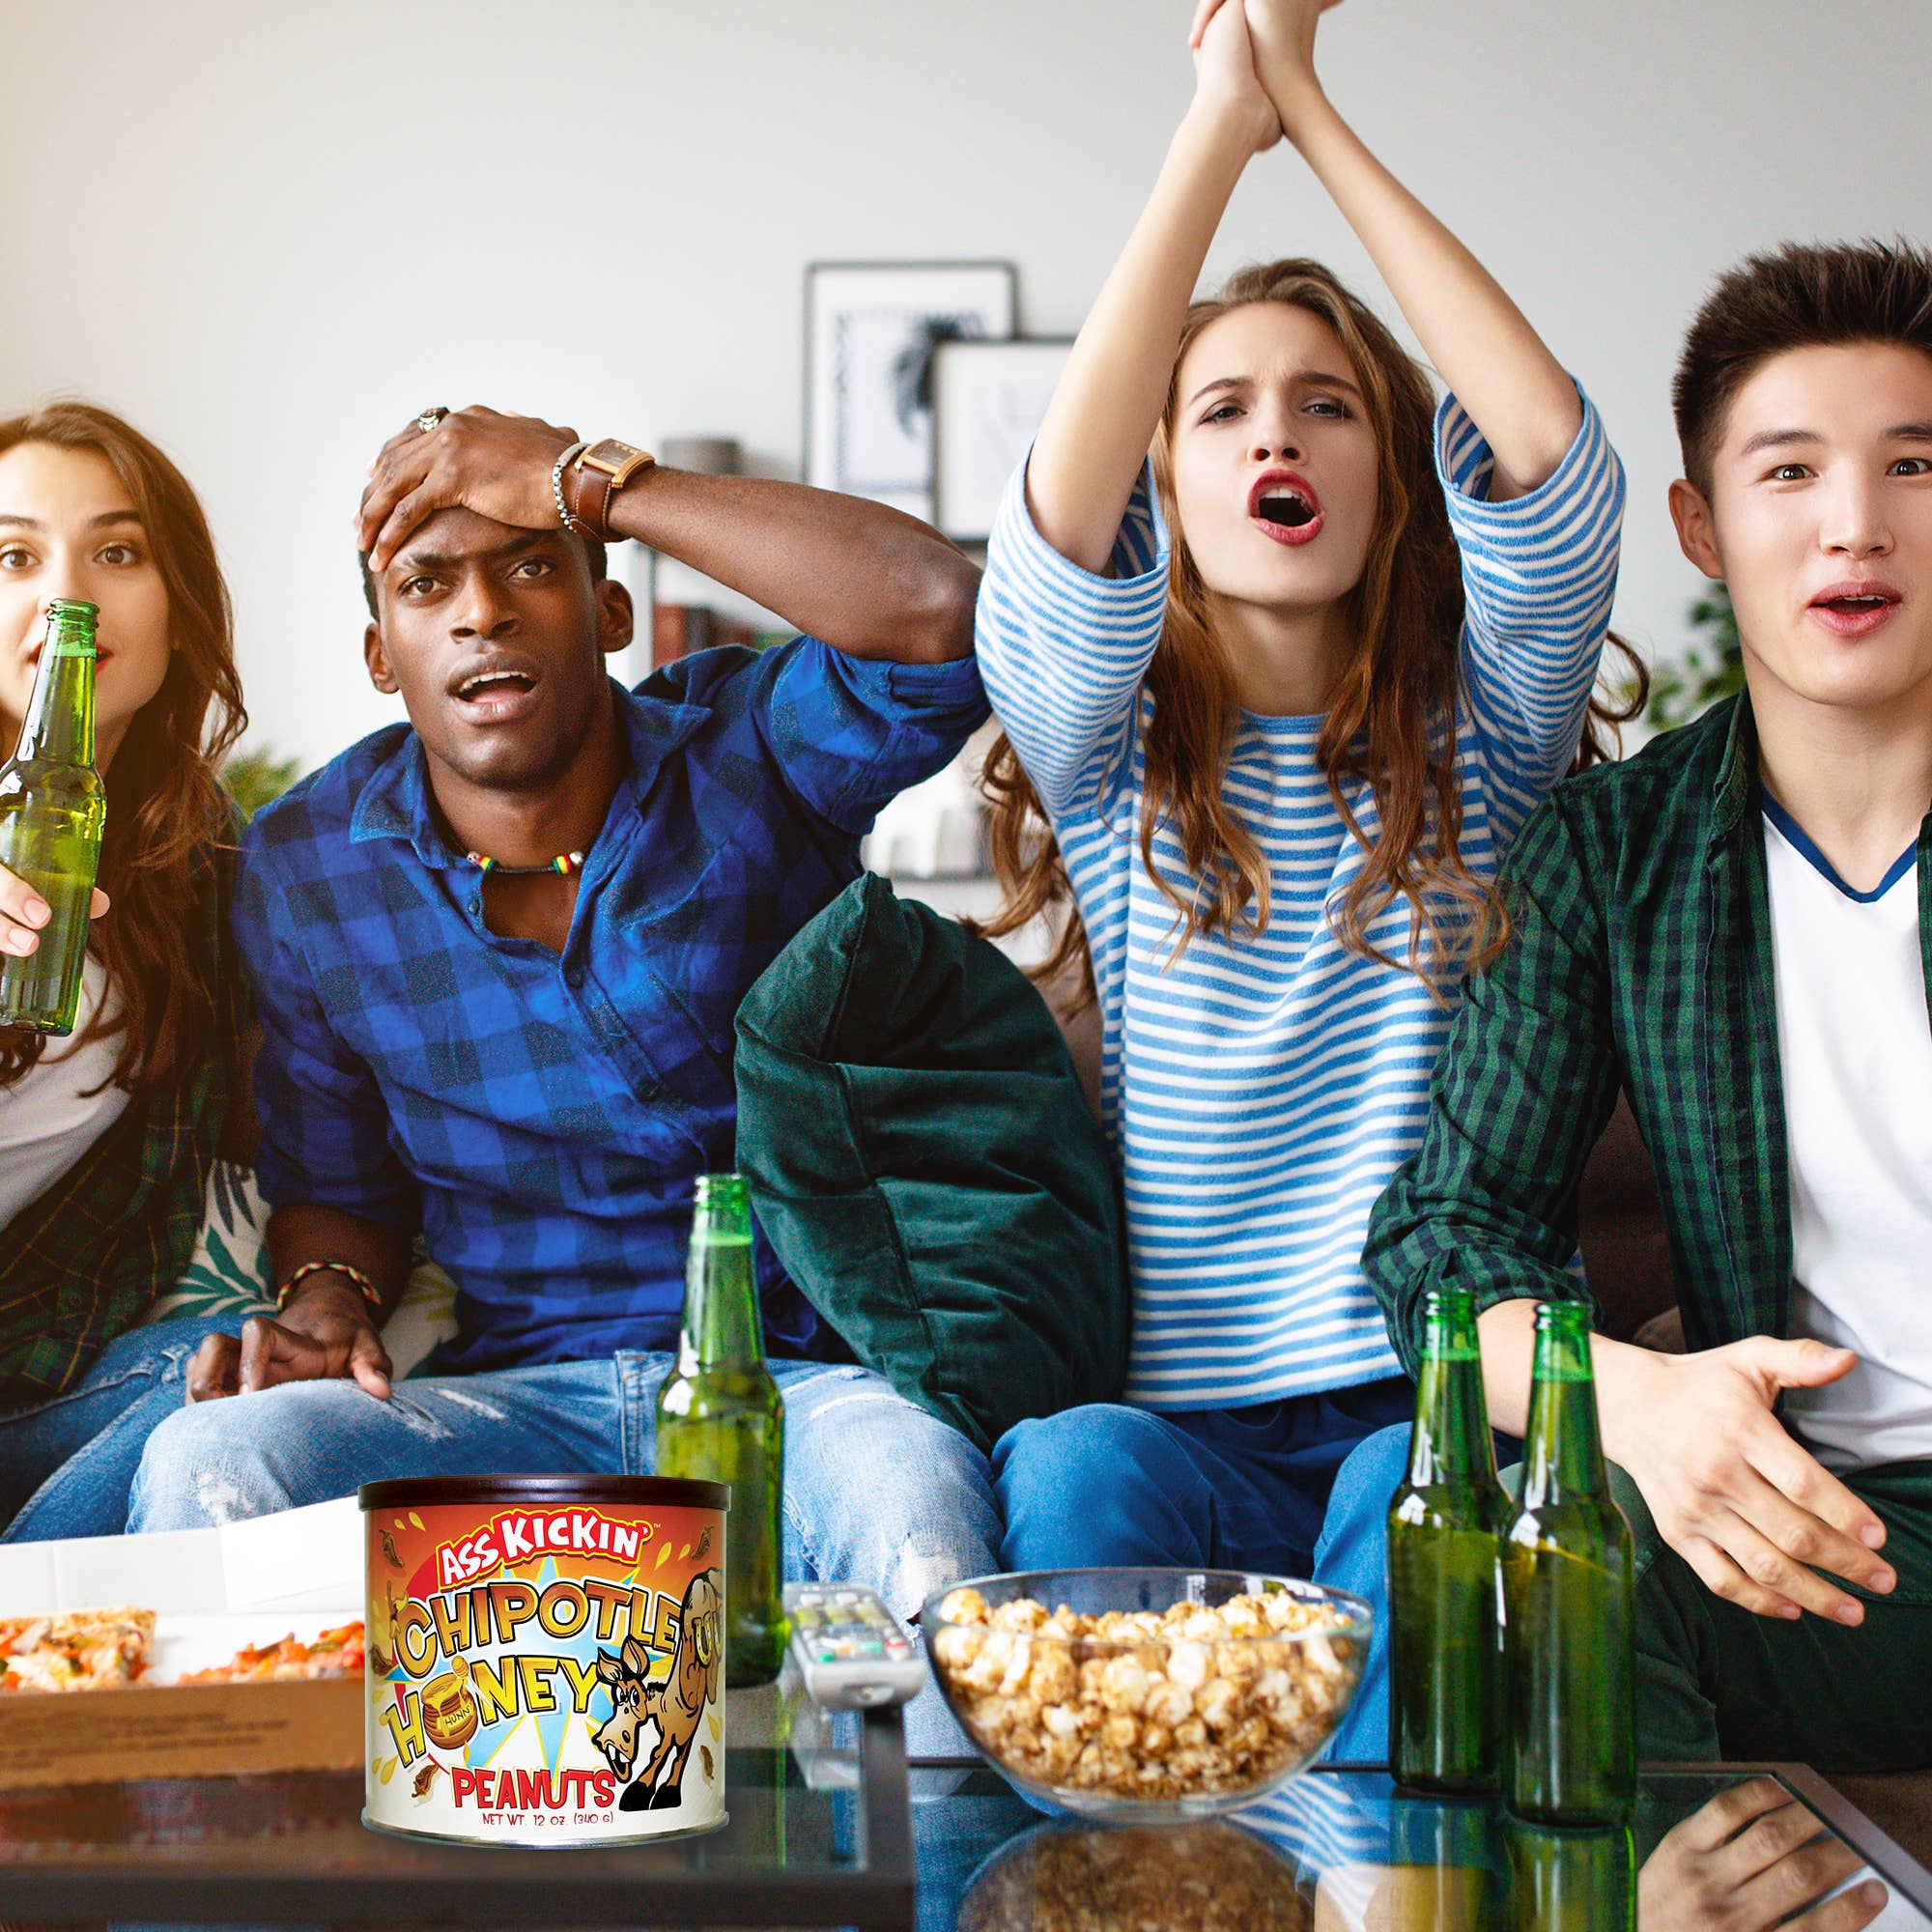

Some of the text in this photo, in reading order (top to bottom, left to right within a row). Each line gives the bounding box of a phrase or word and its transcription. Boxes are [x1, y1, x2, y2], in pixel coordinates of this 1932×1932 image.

[441, 1531, 498, 1585] ASS
[395, 1580, 682, 1677] CHIPOTLE
[387, 1655, 598, 1768] HONEY
[451, 1769, 615, 1810] PEANUTS
[482, 1812, 503, 1826] NET
[533, 1814, 546, 1826] 12
[573, 1812, 599, 1824] (340
[602, 1811, 614, 1824] G)
